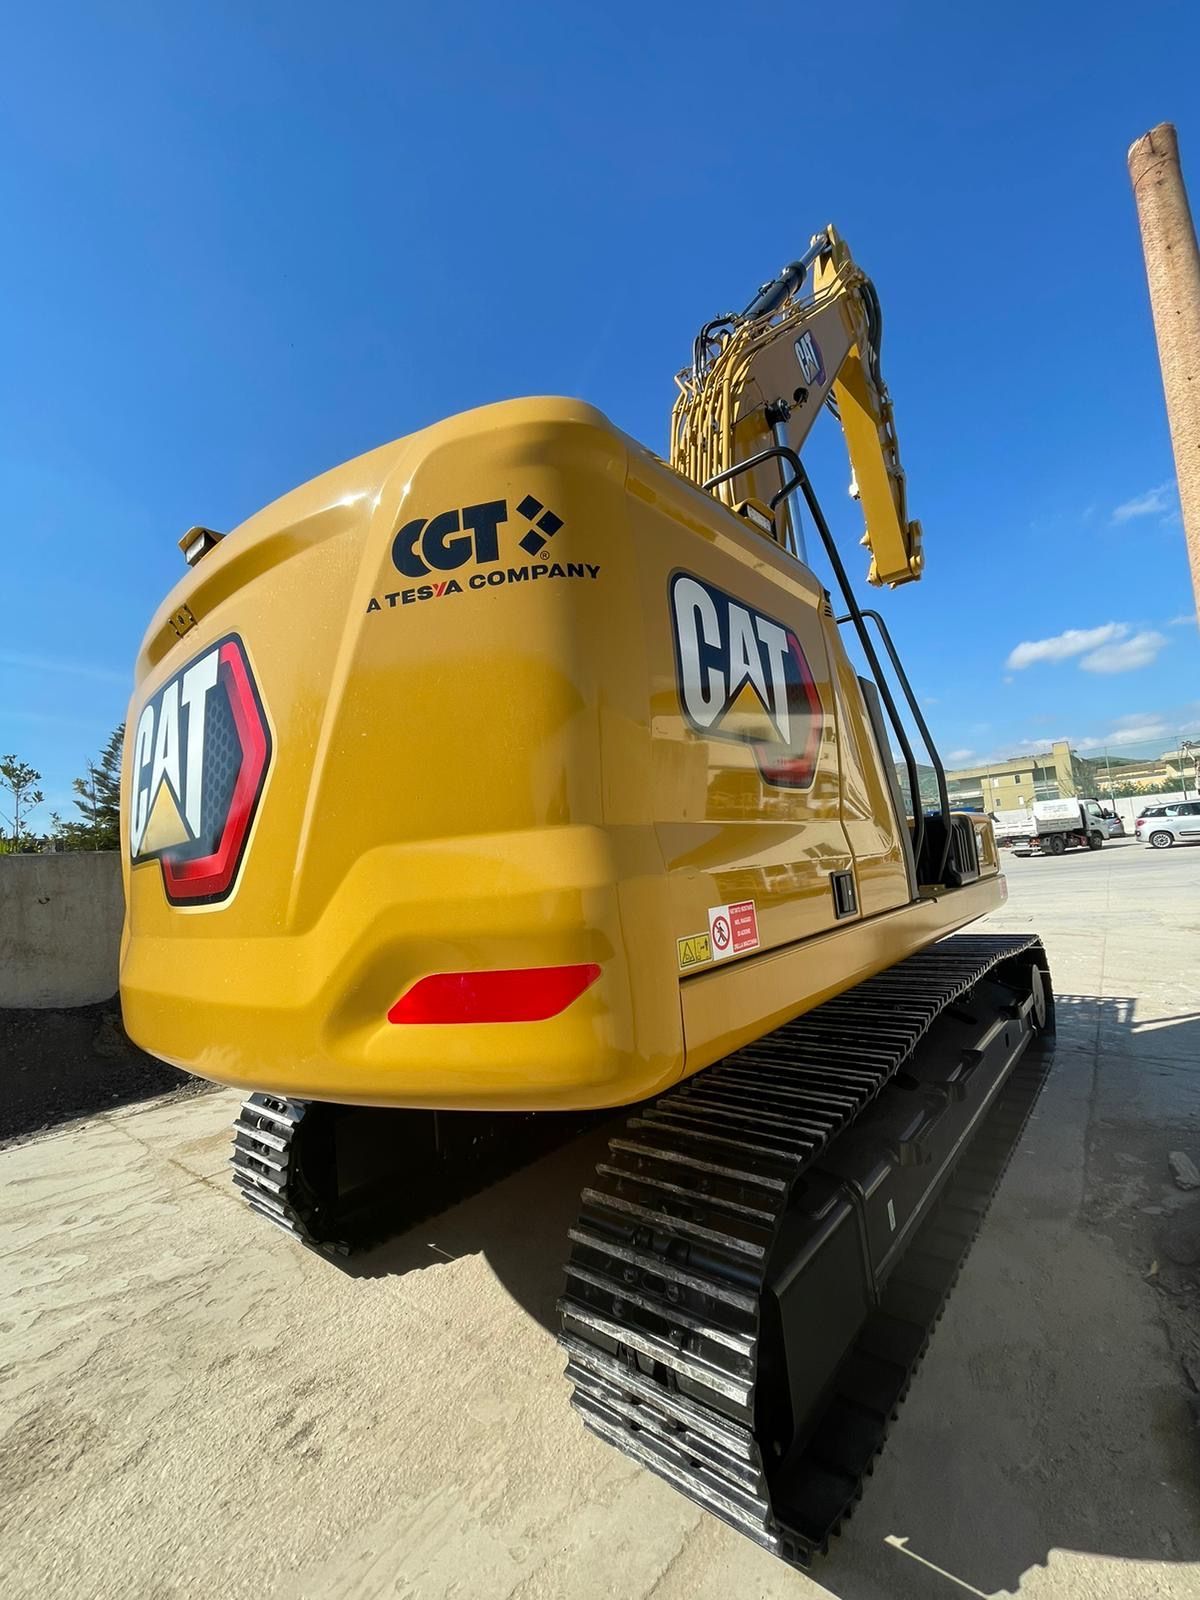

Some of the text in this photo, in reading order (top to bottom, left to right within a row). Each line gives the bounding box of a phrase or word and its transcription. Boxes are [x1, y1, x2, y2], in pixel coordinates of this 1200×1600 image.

[795, 331, 820, 385] CAT
[391, 499, 508, 578] CGT
[366, 563, 601, 613] A TESYA COMPANY
[674, 577, 791, 745] CAT
[130, 648, 220, 858] CAT
